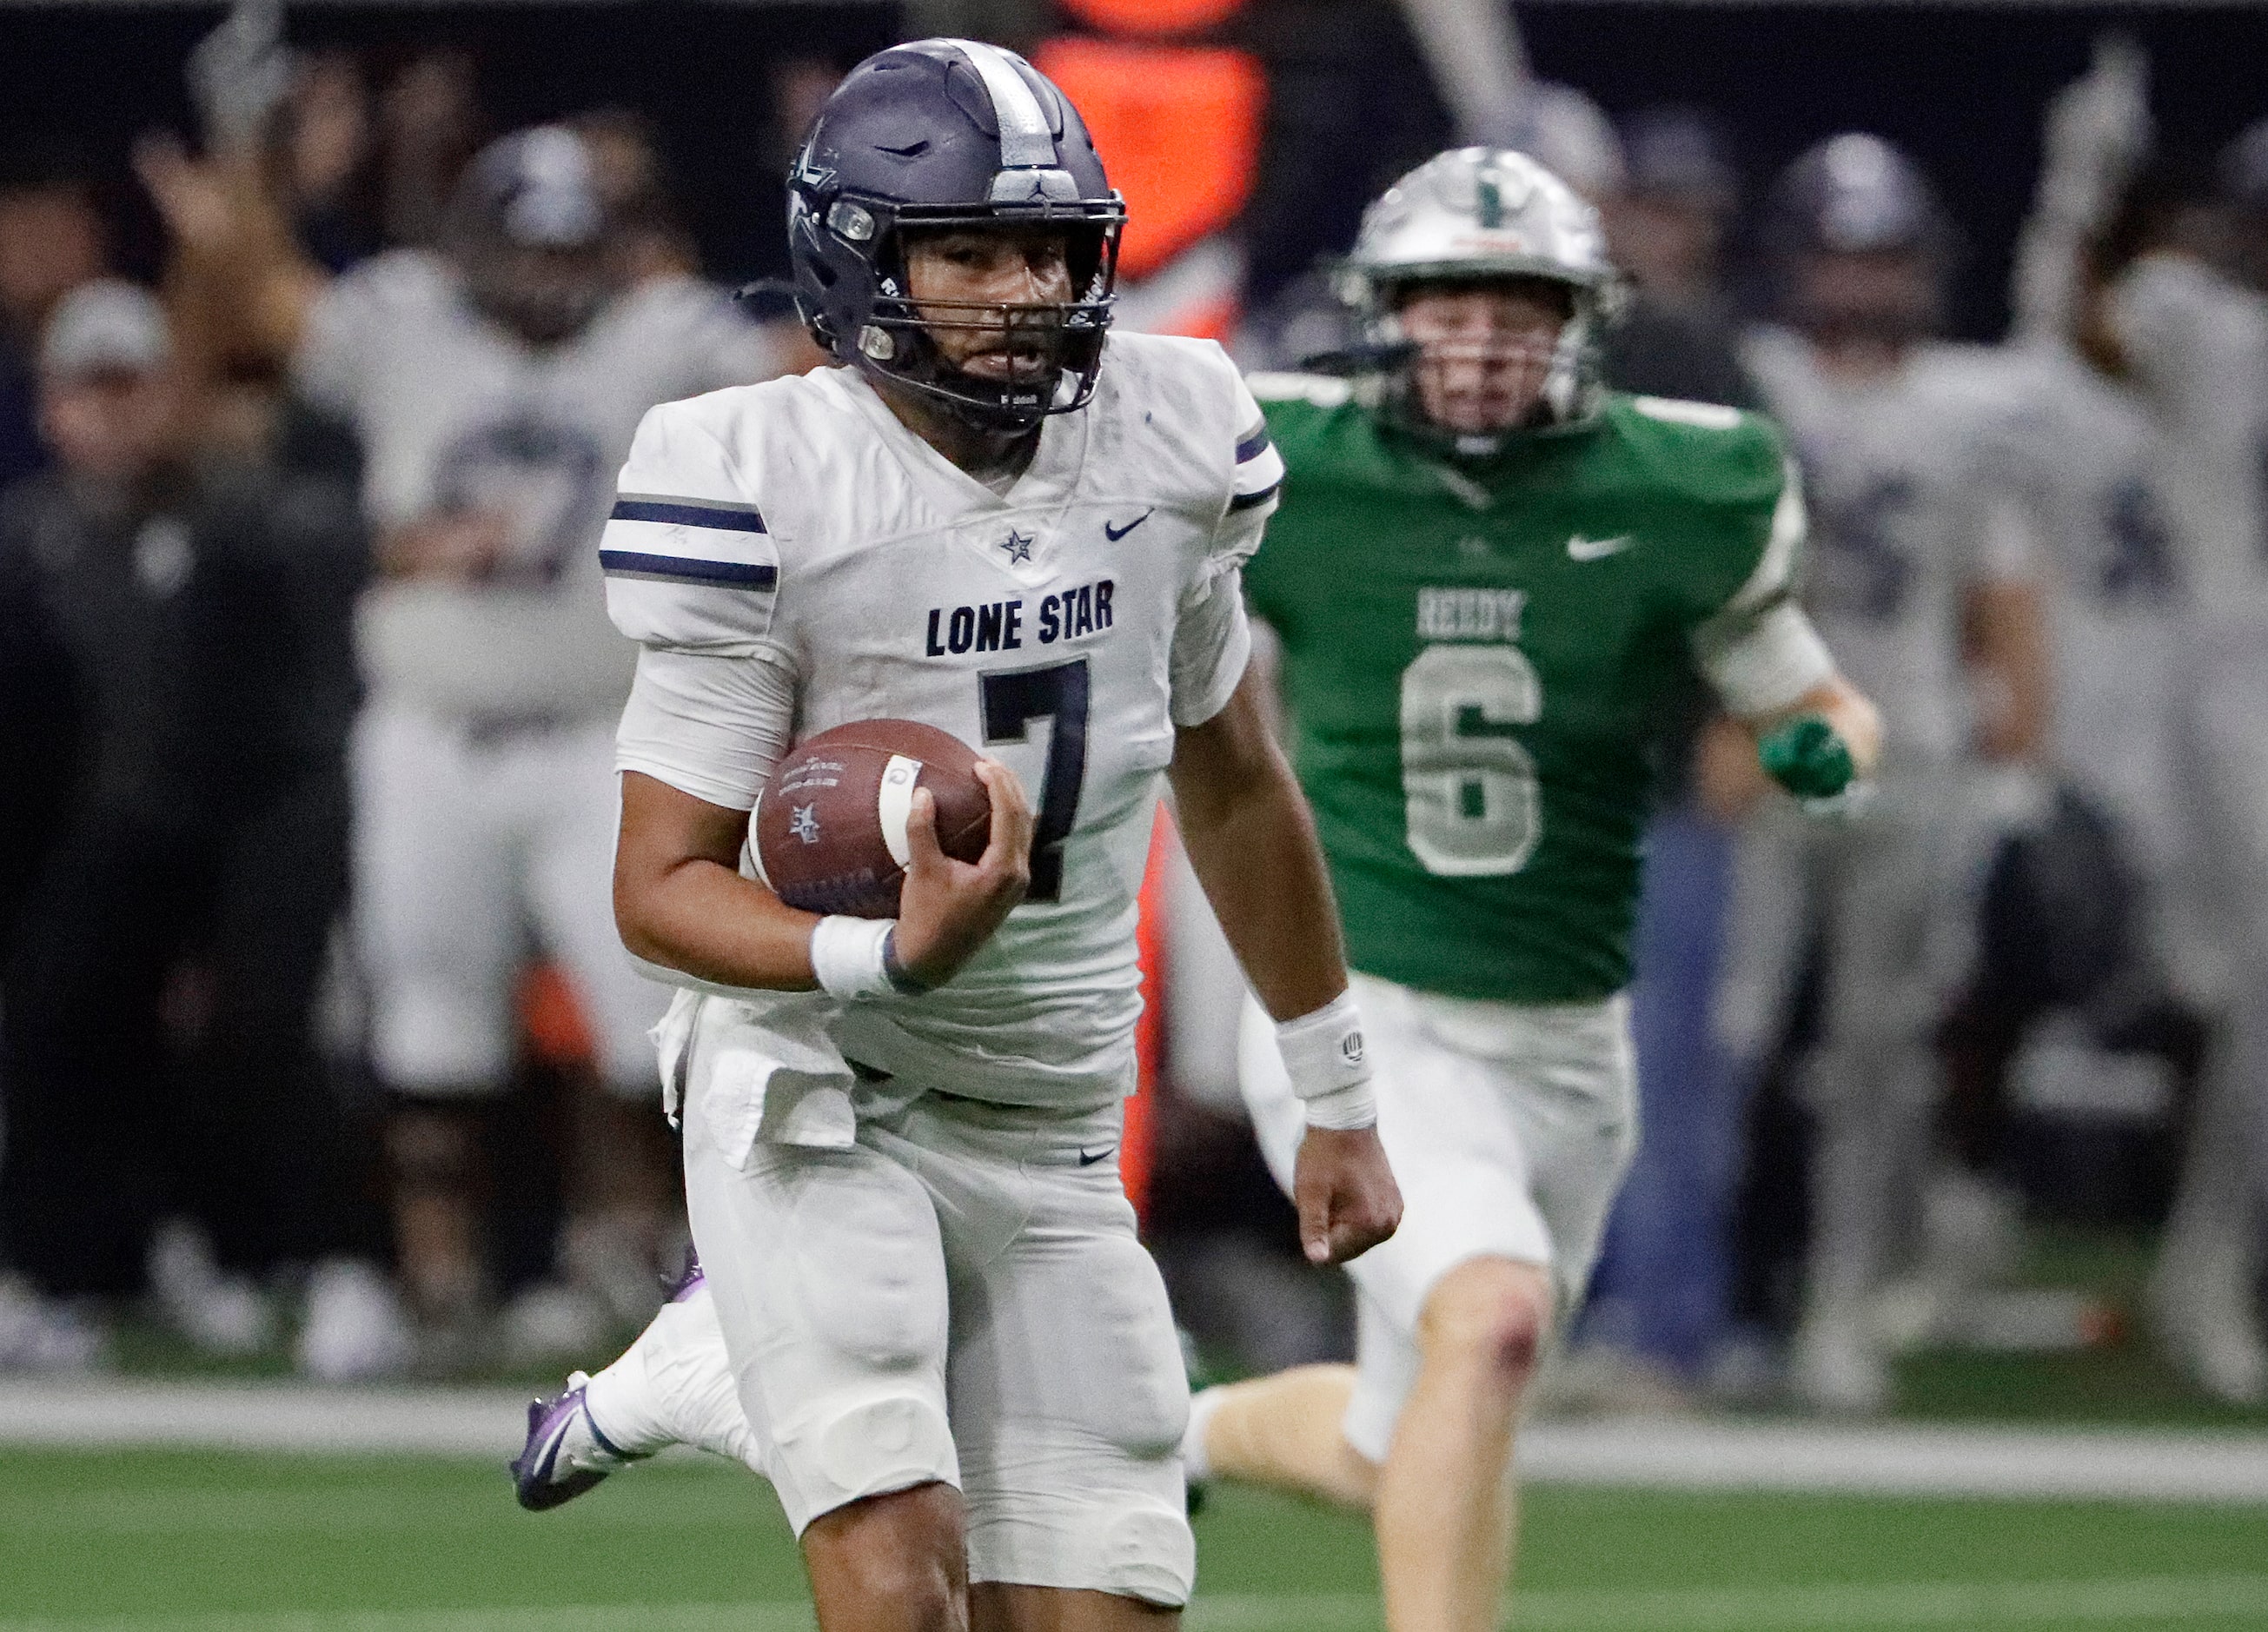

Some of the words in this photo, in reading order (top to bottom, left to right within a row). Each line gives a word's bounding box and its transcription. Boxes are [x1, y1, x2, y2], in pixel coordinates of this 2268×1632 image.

[926, 600, 1023, 657] LONE
[1038, 579, 1115, 645] STAR
[978, 653, 1091, 904] 7
[1401, 642, 1543, 877] 6
